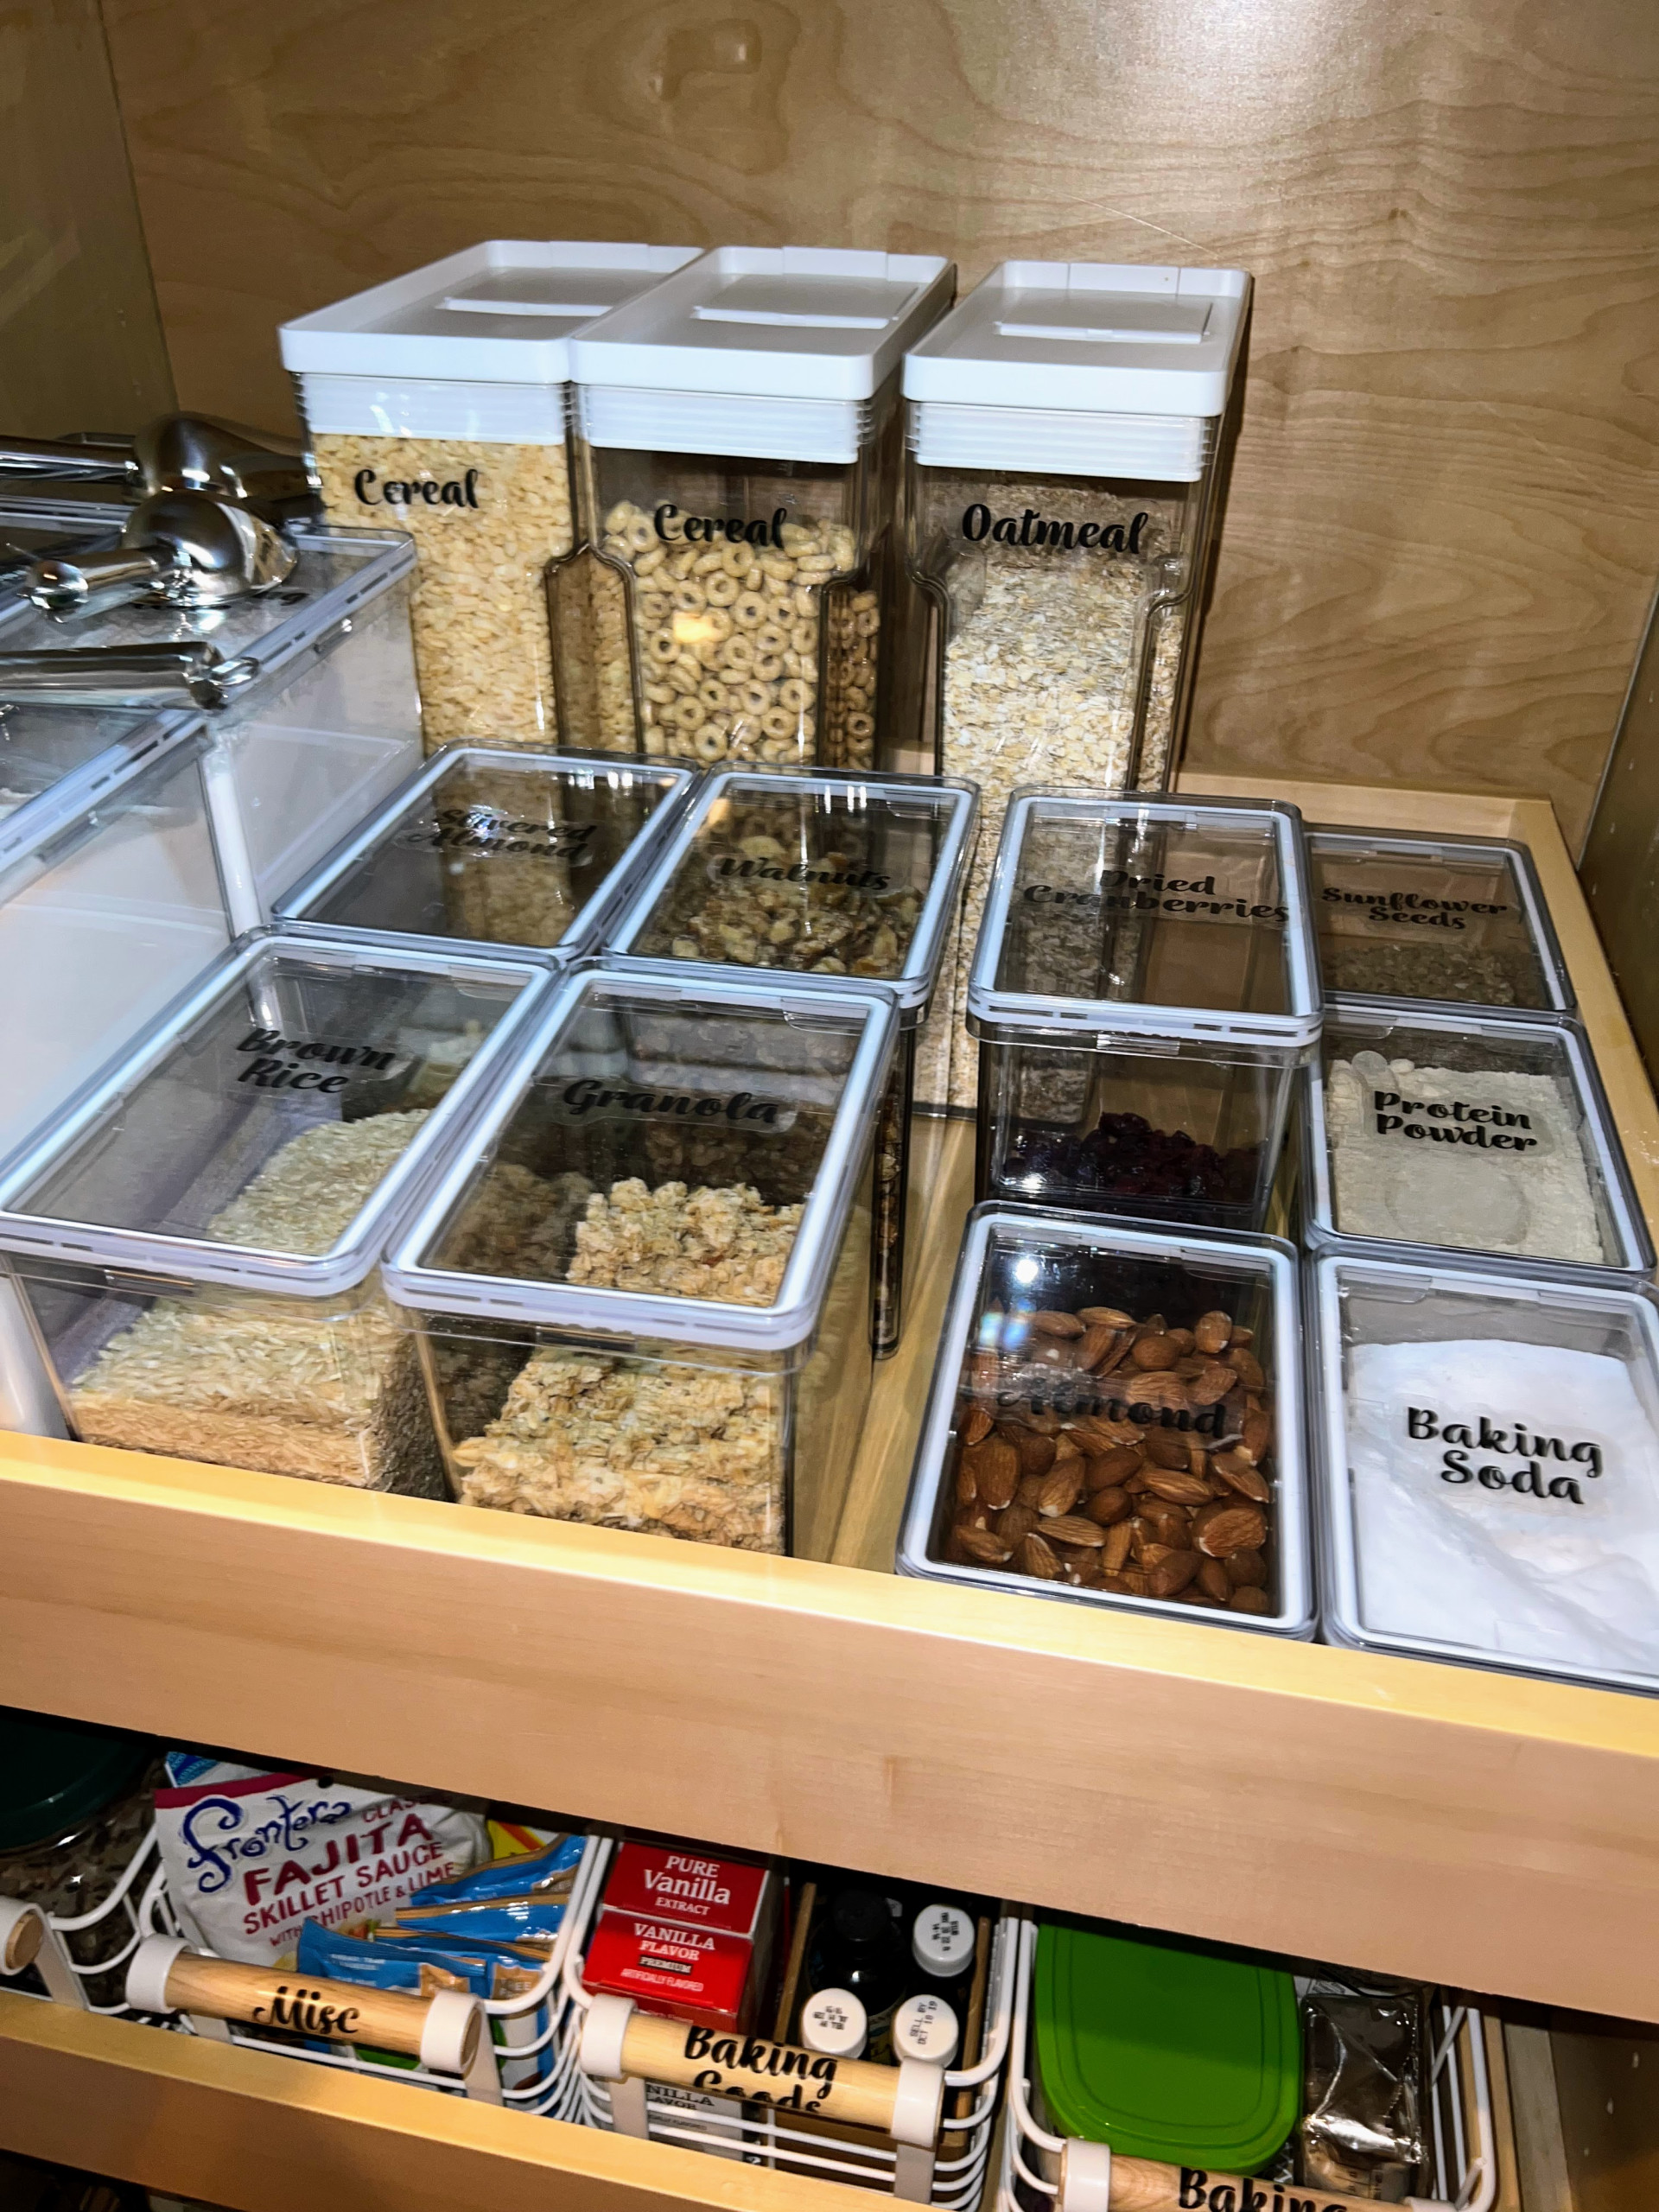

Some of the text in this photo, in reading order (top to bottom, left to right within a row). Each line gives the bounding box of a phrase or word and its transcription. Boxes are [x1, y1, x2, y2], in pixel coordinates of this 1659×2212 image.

[354, 468, 479, 508] Cereal
[653, 503, 788, 549] Cereal
[962, 503, 1149, 555] Oatmeal
[408, 828, 588, 859] Almond
[719, 857, 891, 890] Walnuts
[1100, 869, 1216, 895] Dried
[1023, 884, 1290, 922] Cranberries
[1321, 887, 1508, 914] Sunflower
[1369, 907, 1466, 930] Seeds
[236, 1027, 396, 1070] Brown
[238, 1057, 350, 1093] Rice
[563, 1080, 779, 1123] Granola
[1374, 1090, 1532, 1130] Protein
[1376, 1113, 1538, 1152] Powder
[997, 1377, 1225, 1439] Almond
[1408, 1406, 1602, 1478] Baking
[1440, 1450, 1585, 1504] Soda
[179, 1795, 353, 1893] Frontera
[243, 1813, 433, 1905] FAJITA
[664, 1855, 721, 1878] PURE
[243, 1841, 443, 1935] SKILLET SAUCE
[644, 1869, 732, 1905] Vanilla
[655, 1897, 711, 1916] EXTRACT
[270, 1923, 303, 1947] WITH
[633, 1923, 716, 1950] VANILLA
[639, 1940, 700, 1961] FLAVOR
[684, 2024, 838, 2100] Baking
[645, 2082, 715, 2107] NILLA
